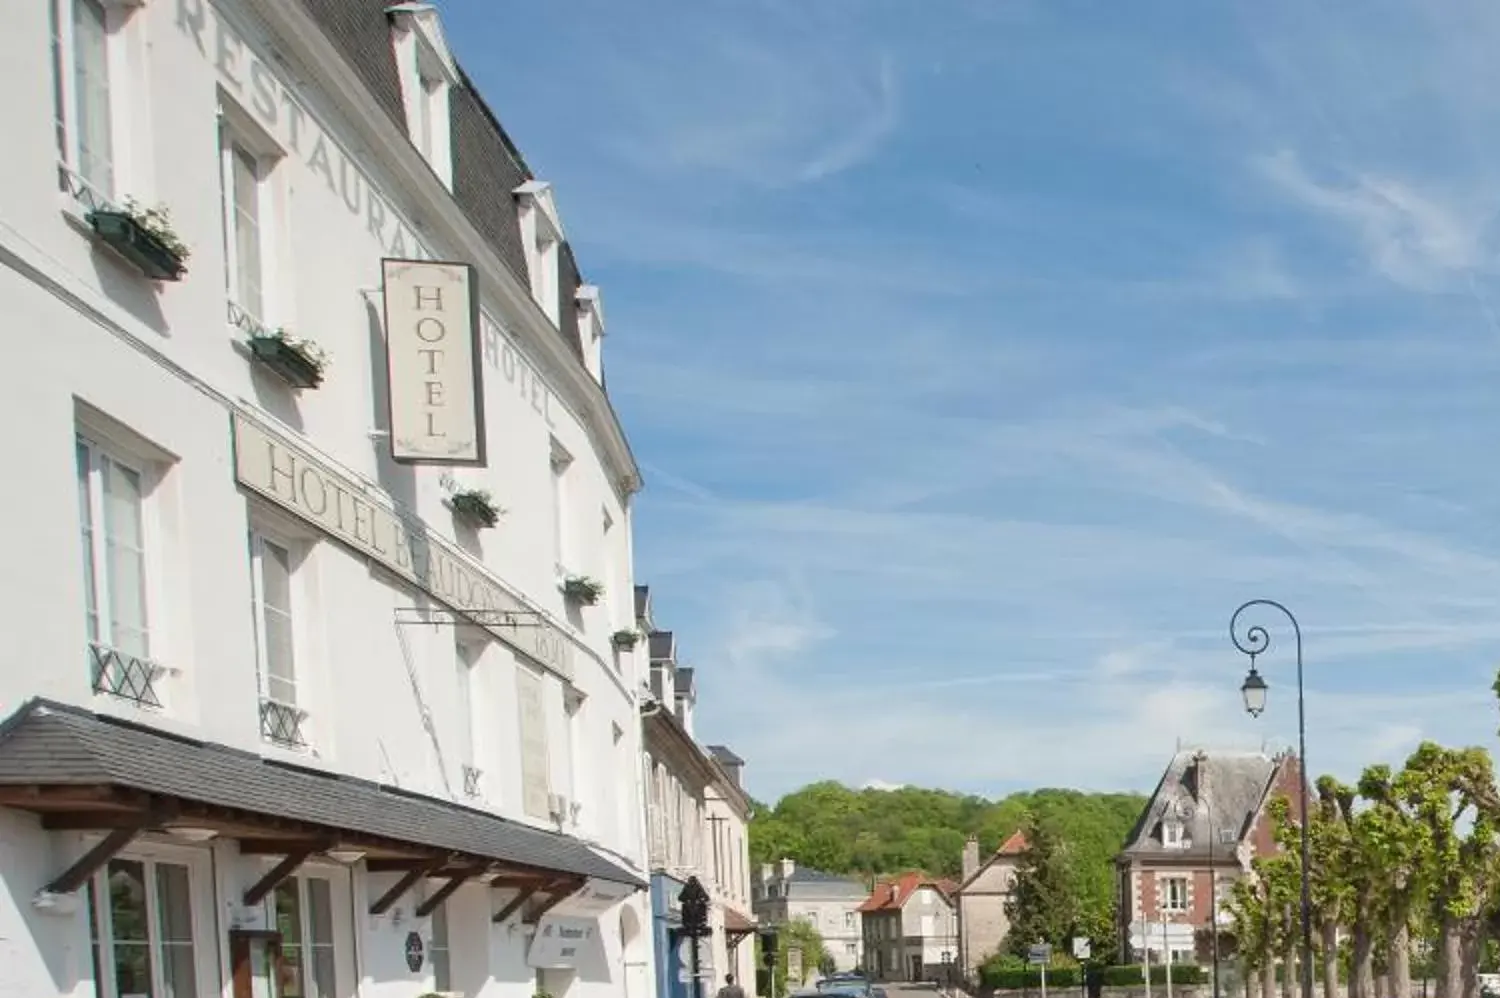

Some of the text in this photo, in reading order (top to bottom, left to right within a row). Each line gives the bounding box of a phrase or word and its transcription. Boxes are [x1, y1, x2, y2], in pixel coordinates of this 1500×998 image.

[176, 0, 556, 430] RESTAURA HOTEL
[413, 285, 447, 438] HOTEL
[266, 442, 386, 555] HOTEL
